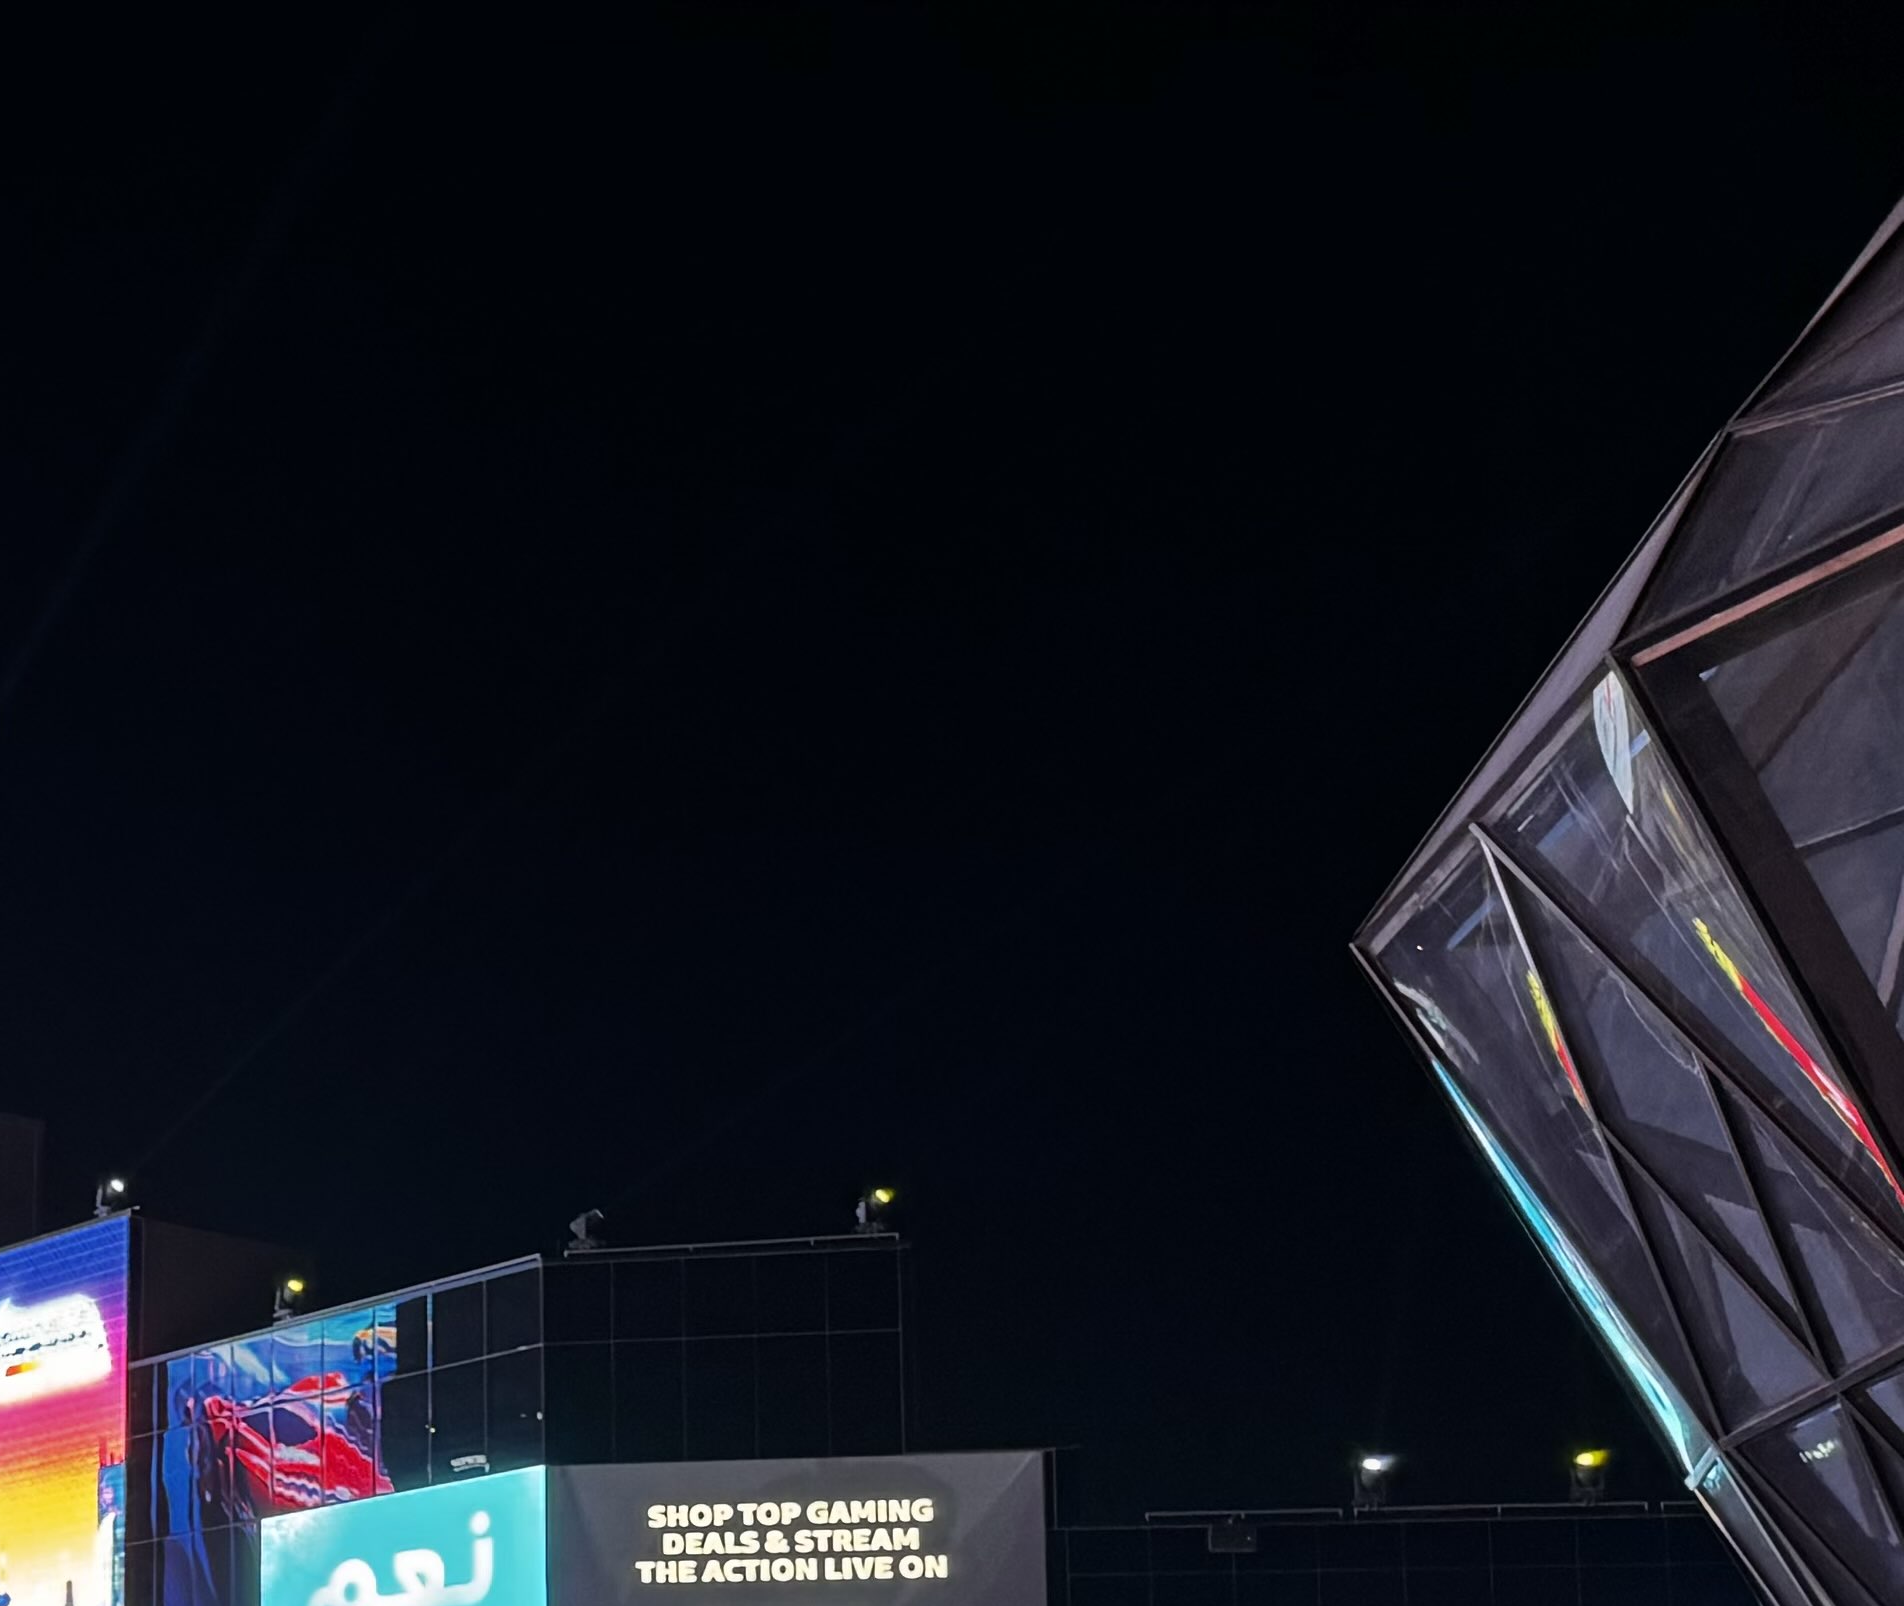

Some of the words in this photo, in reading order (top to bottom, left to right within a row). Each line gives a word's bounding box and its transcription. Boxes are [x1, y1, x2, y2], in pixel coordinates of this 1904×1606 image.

[647, 1503, 735, 1529] SHOP
[739, 1501, 801, 1527] TOP
[806, 1498, 935, 1526] GAMING
[662, 1530, 761, 1557] DEALS
[764, 1531, 790, 1555] &
[794, 1528, 921, 1554] STREAM
[635, 1560, 697, 1584] THE
[701, 1557, 820, 1584] ACTION
[824, 1557, 895, 1582] LIVE
[898, 1555, 949, 1580] ON
